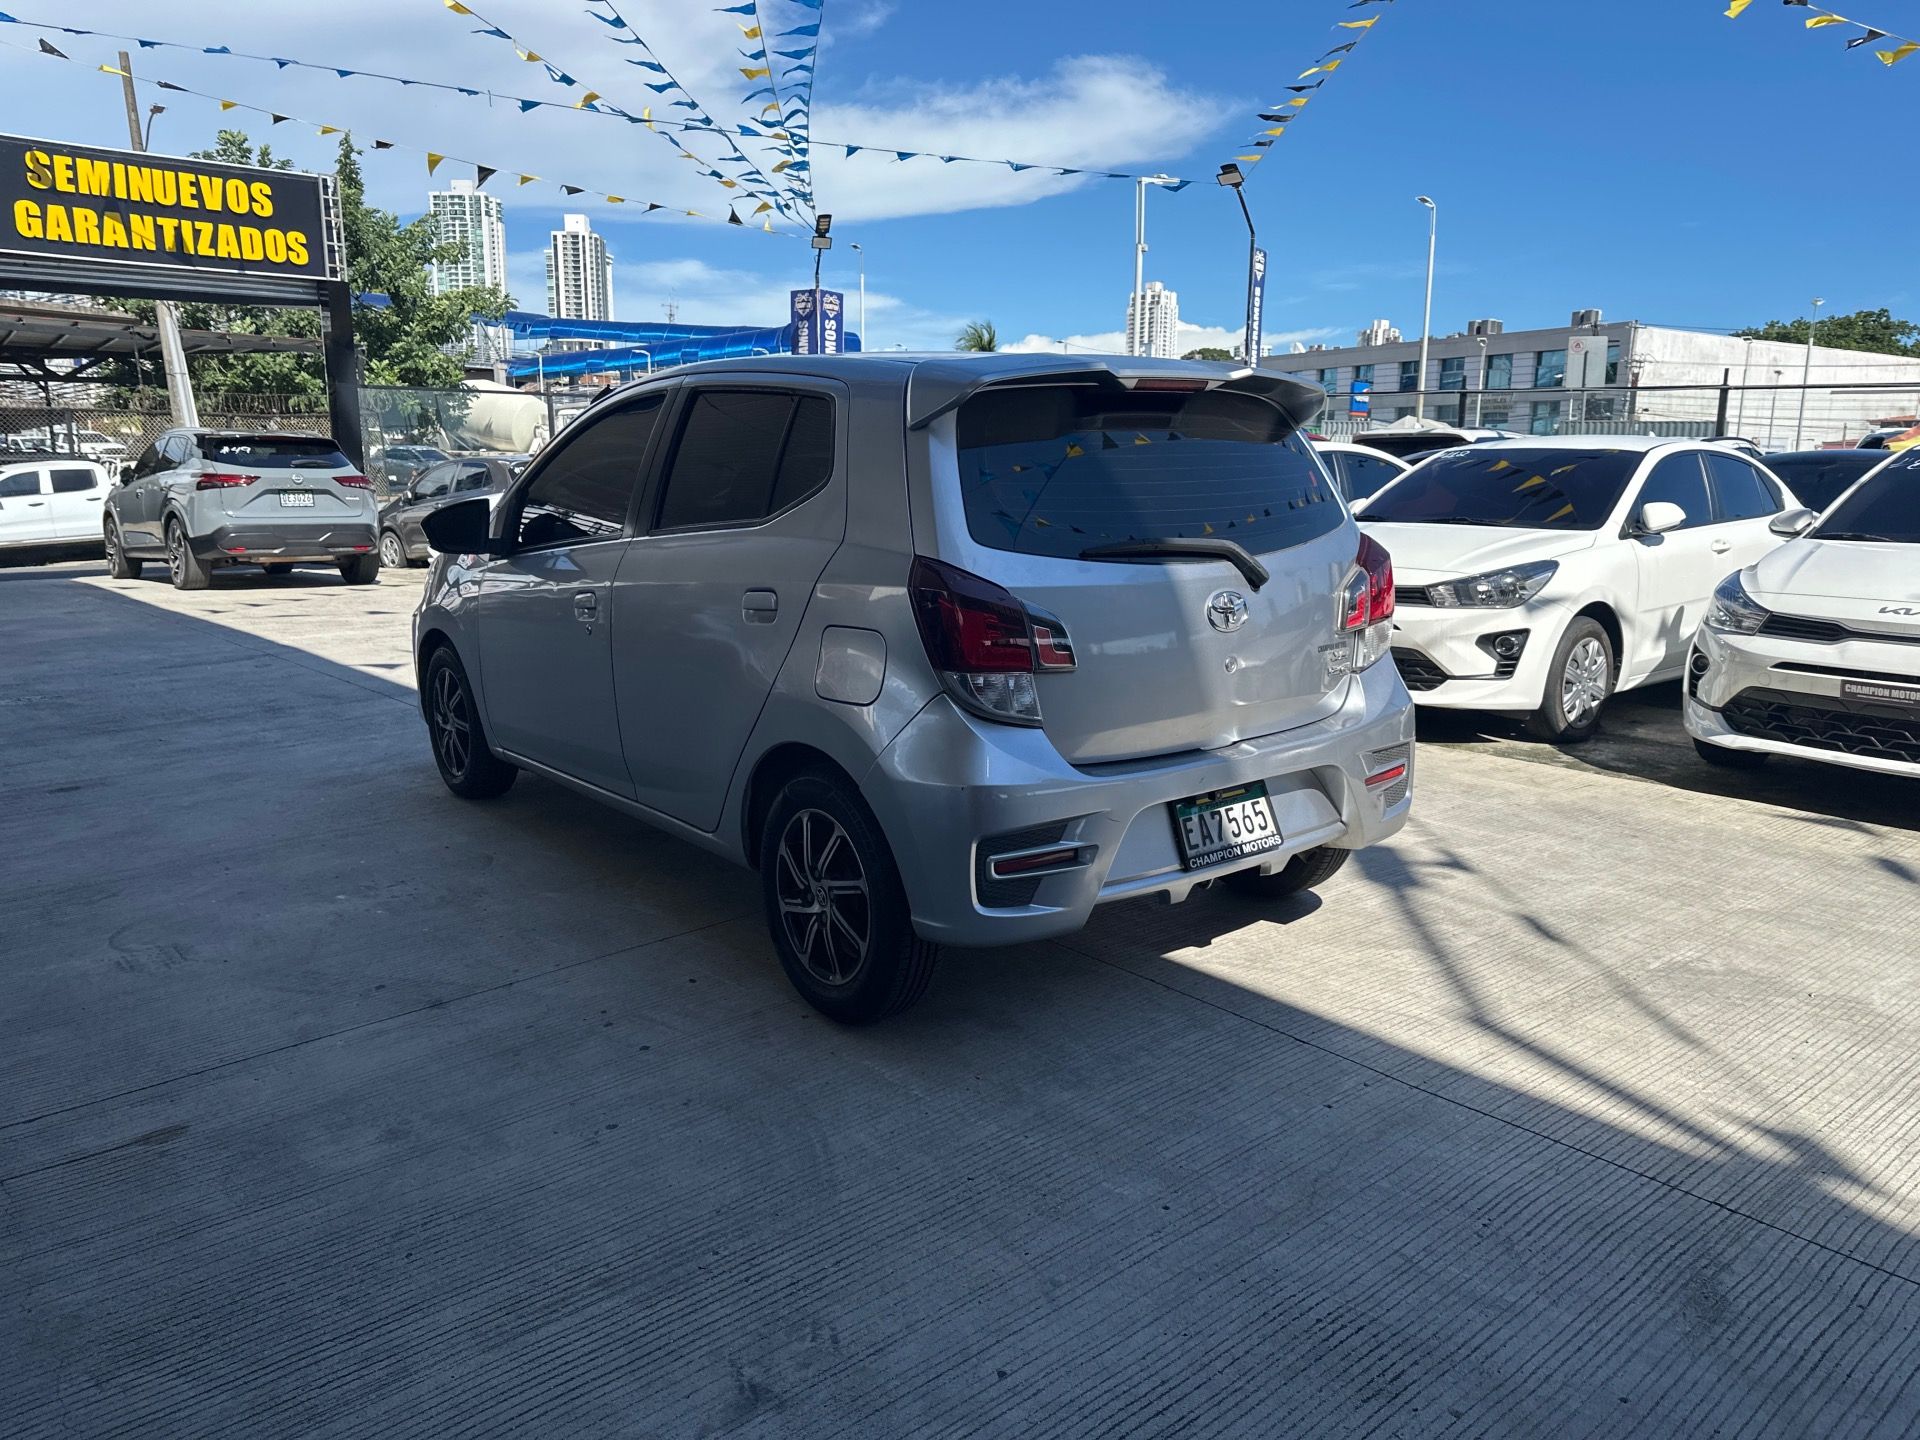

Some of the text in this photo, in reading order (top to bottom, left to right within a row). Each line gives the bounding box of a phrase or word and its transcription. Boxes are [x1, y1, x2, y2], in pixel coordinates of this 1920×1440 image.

[24, 149, 274, 218] SEMINUEVOS
[13, 198, 310, 266] GARANTIZADOS
[798, 320, 809, 354] AMOS
[825, 319, 837, 354] MOS
[1844, 683, 1891, 697] CHAMPION
[1180, 800, 1268, 851] EA7565
[1189, 834, 1282, 869] CHAMPION MOTORS
